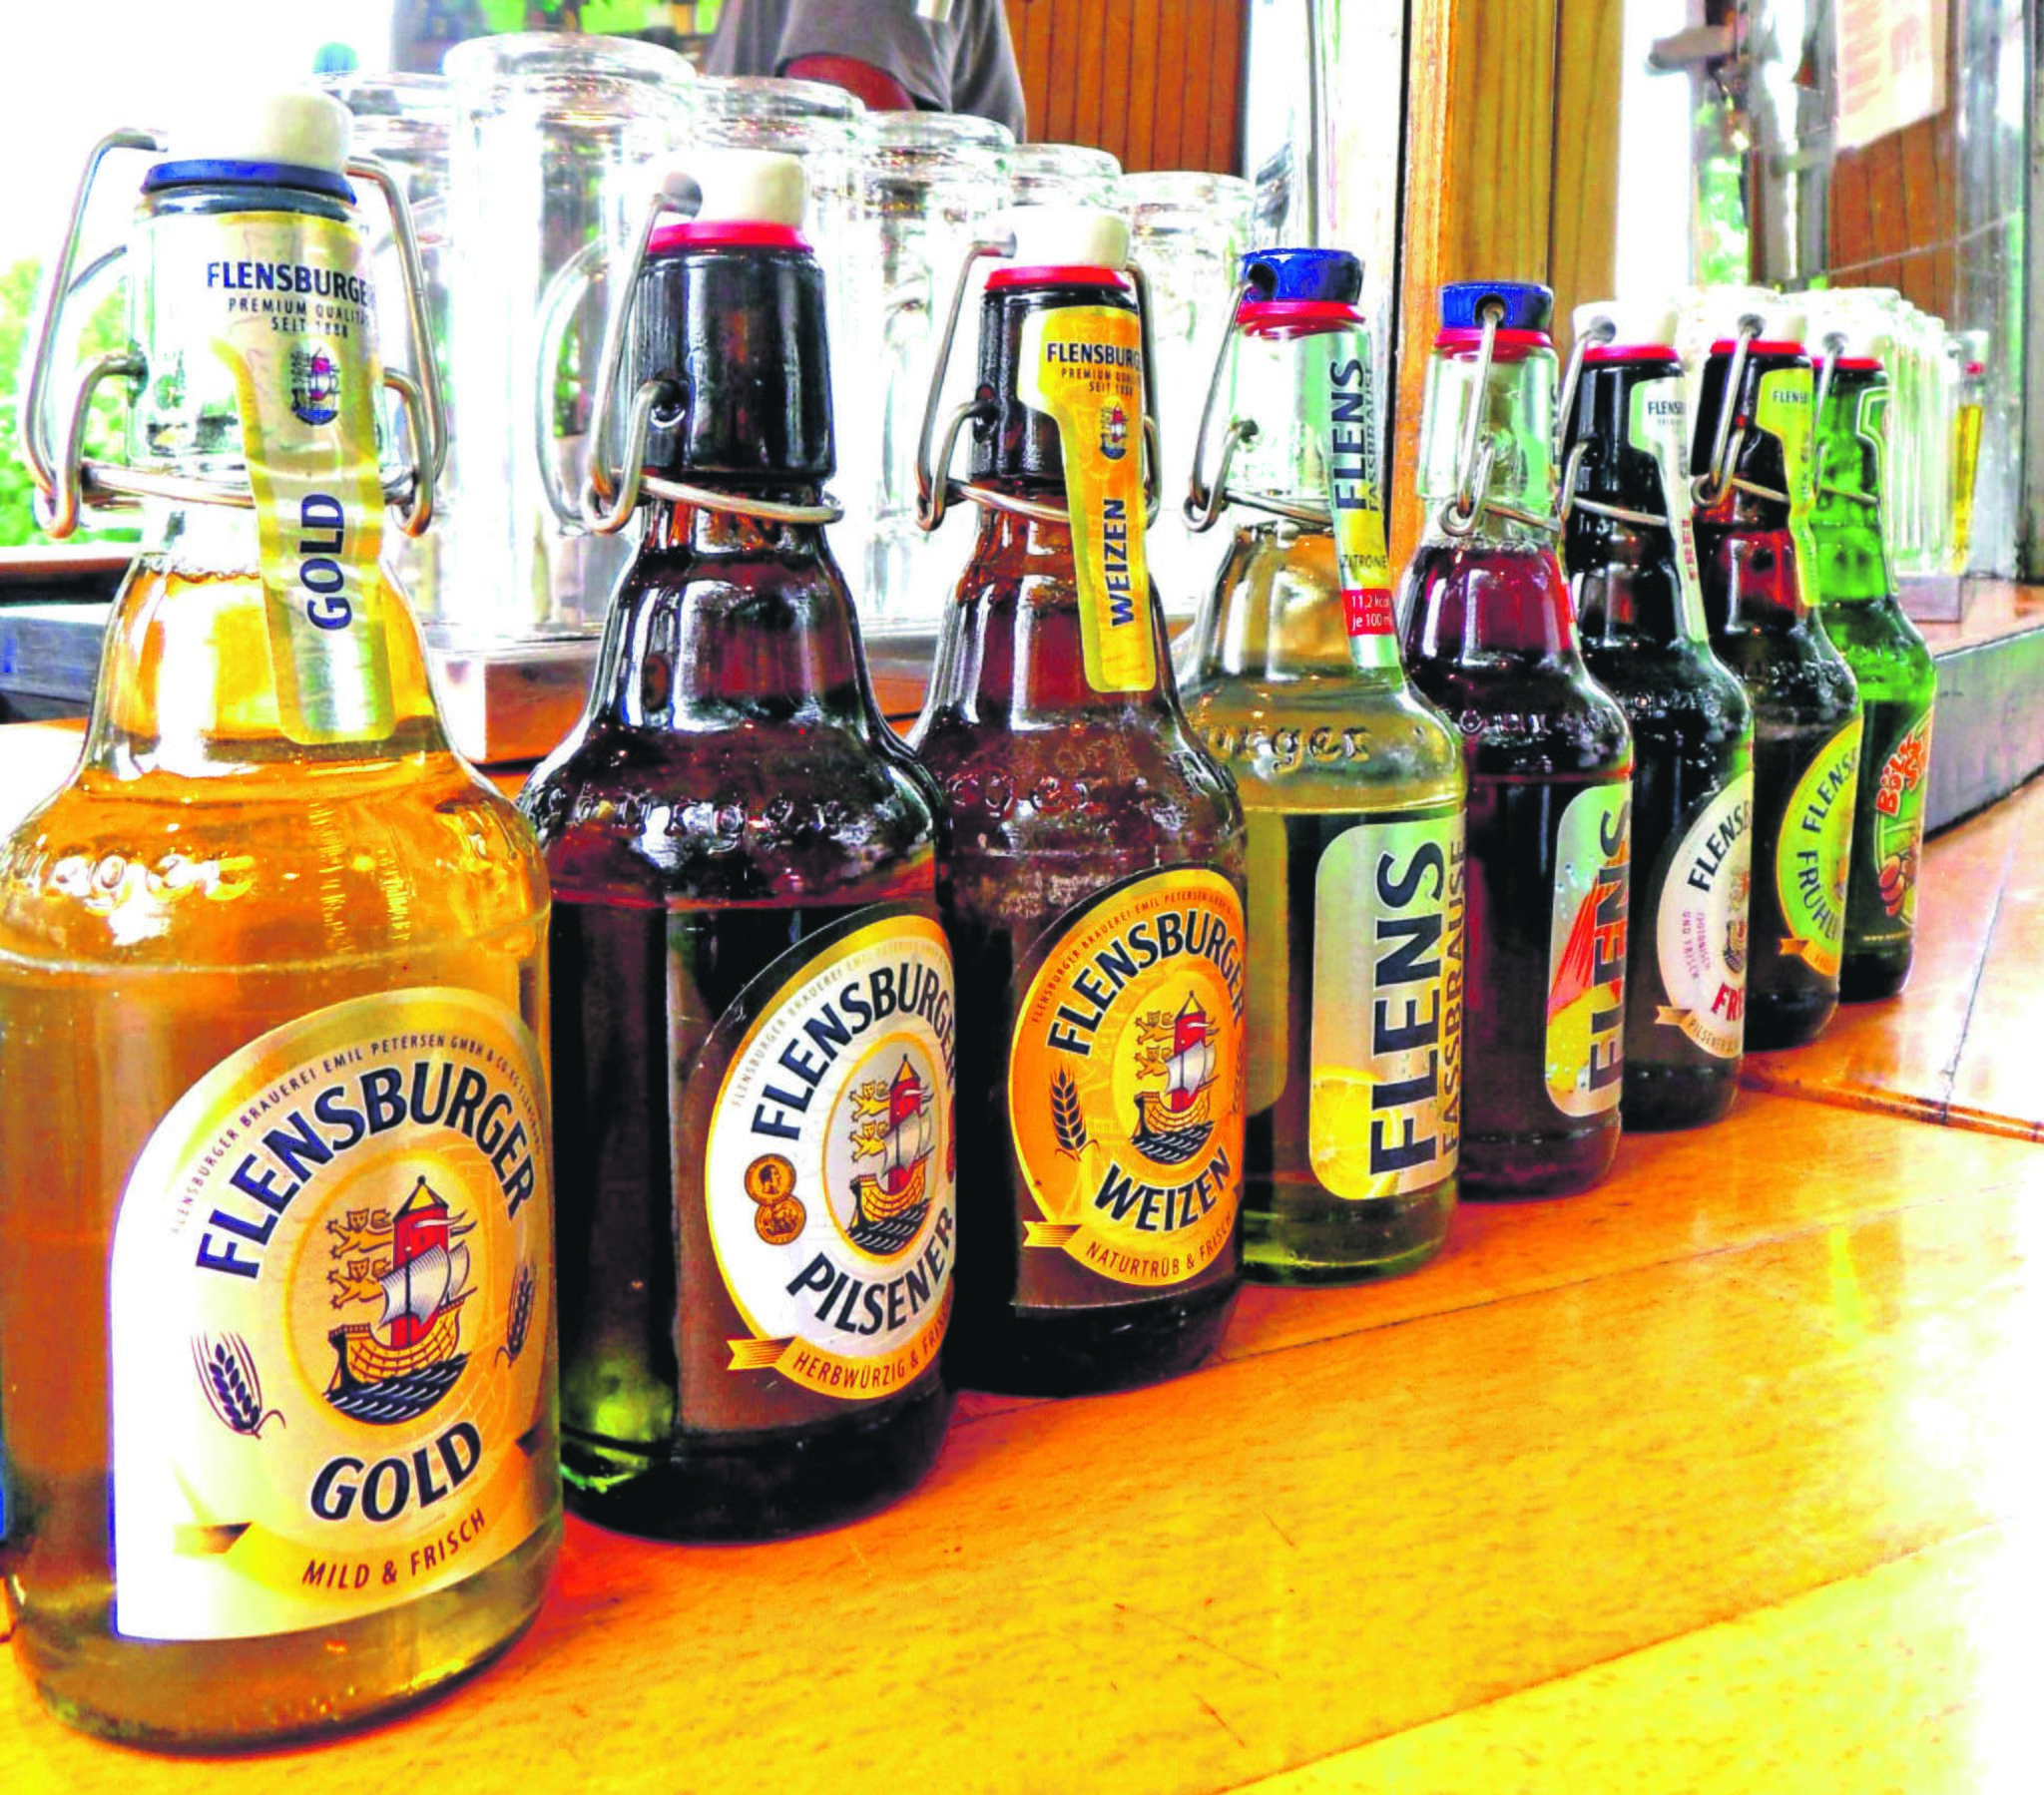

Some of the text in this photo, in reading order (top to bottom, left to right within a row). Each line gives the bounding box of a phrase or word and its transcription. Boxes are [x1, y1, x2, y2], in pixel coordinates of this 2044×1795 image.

[207, 261, 378, 311] FLENSBURGE
[229, 297, 371, 328] PREMIUM QUALIT
[271, 316, 306, 333] SEIT
[1329, 358, 1368, 510] FLENS
[299, 493, 353, 631] GOLD
[1103, 499, 1135, 627] WEIZEN
[1352, 615, 1363, 632] je
[1365, 613, 1382, 628] 100
[1370, 841, 1444, 1174] FLENS
[1442, 840, 1465, 1155] FASSBRAUSE
[239, 1067, 316, 1128] BRAUEREI
[321, 1048, 363, 1075] EMIL
[370, 1035, 445, 1058] PETERSEN
[196, 1061, 536, 1279] FLENSBURGER
[1094, 1145, 1232, 1232] WEIZEN
[785, 1206, 953, 1336] PILSENER
[1086, 1241, 1180, 1278] NATURTRÜB
[1186, 1253, 1195, 1269] &
[792, 1350, 905, 1390] HERBWÜRZIG
[909, 1350, 919, 1369] &
[309, 1421, 483, 1523] GOLD
[301, 1508, 486, 1589] MILD & FRISCH
